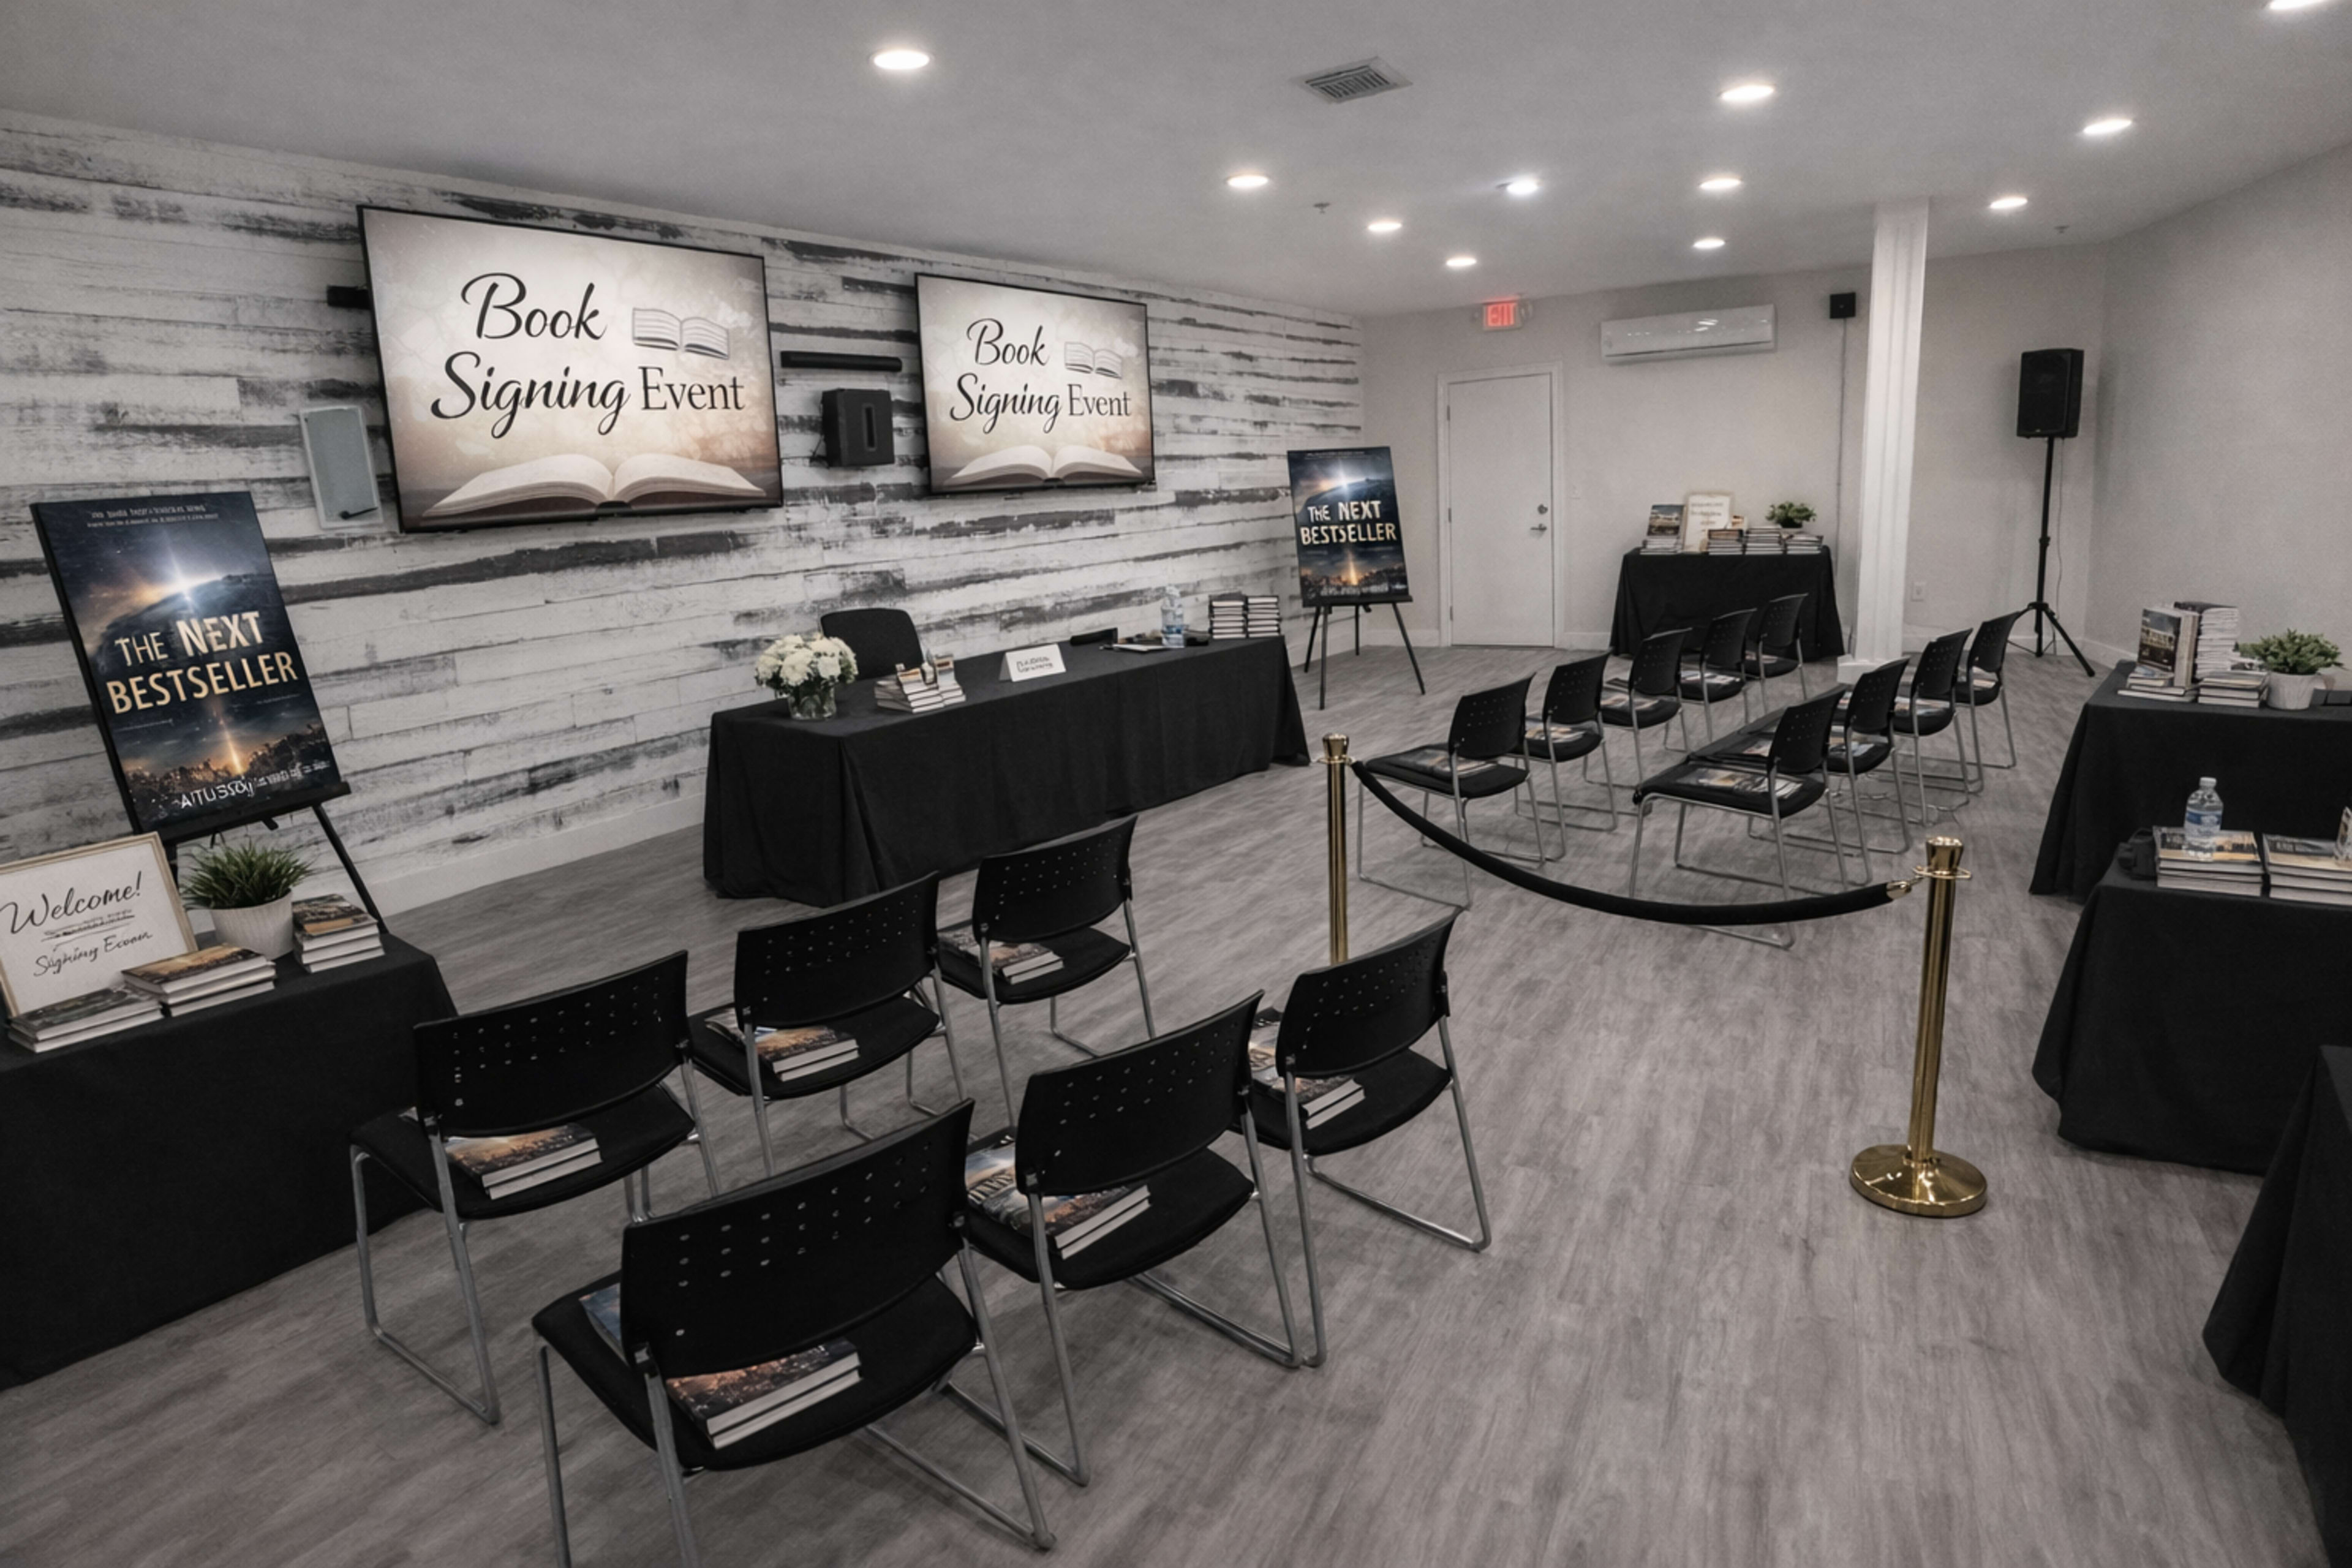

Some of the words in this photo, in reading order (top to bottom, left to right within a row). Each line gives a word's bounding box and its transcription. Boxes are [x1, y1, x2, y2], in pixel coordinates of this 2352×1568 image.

[461, 273, 606, 340] Book
[966, 318, 1049, 366] Book
[431, 351, 630, 439] Signing
[638, 366, 745, 411] Event
[949, 372, 1061, 434] Signing
[1068, 383, 1132, 417] Event
[1300, 523, 1397, 545] BESTSELLER
[1307, 503, 1332, 522] THE
[1338, 500, 1382, 521] NEXT
[114, 631, 169, 667] THE
[175, 611, 264, 657] NEXT
[106, 651, 298, 714] BESTSELLER
[0, 870, 141, 935] Welcome!
